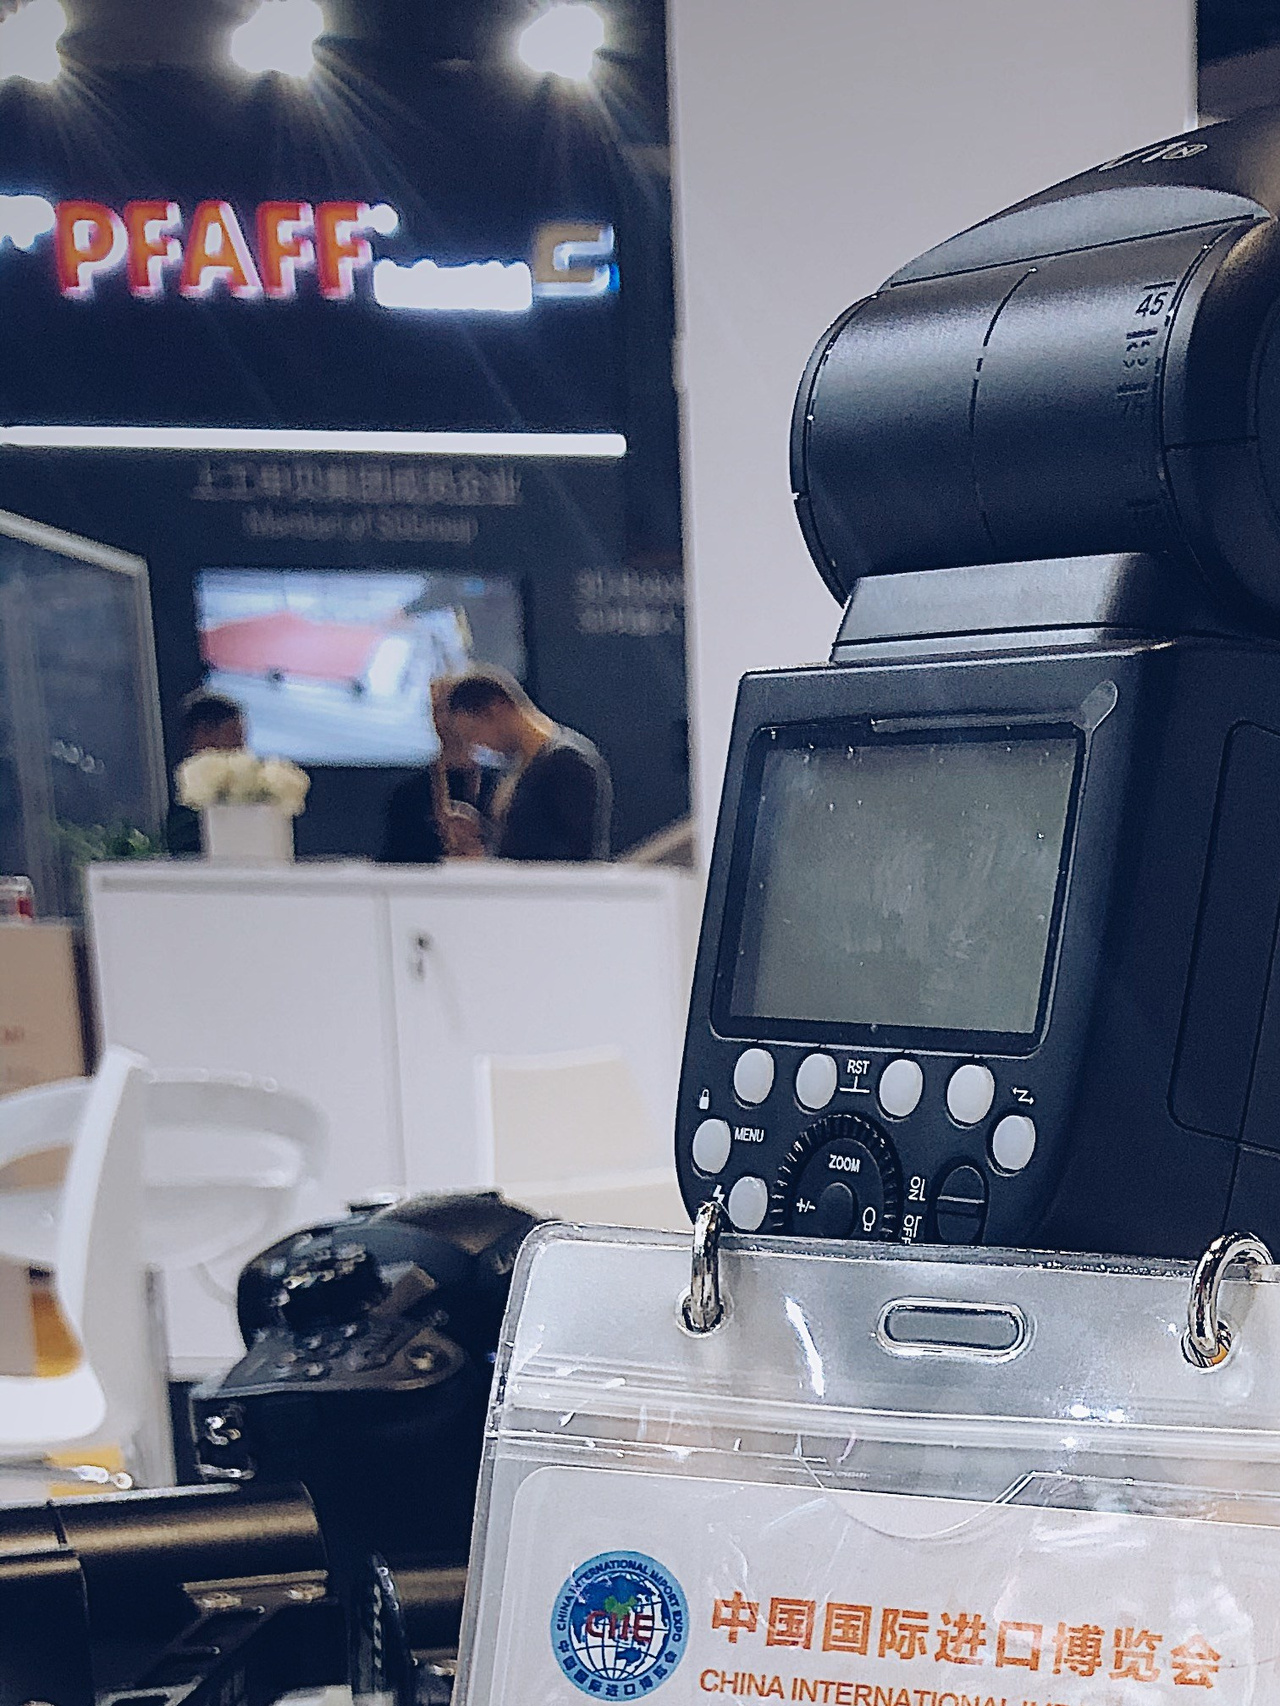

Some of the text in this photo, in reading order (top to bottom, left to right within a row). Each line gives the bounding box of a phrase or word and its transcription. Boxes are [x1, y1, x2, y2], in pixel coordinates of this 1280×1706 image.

[55, 200, 374, 298] PFAFF
[1135, 291, 1168, 316] 45
[847, 1059, 870, 1076] RST
[734, 1127, 765, 1143] MENU
[828, 1154, 861, 1173] ZOOM
[908, 1176, 921, 1201] ON
[556, 1595, 576, 1632] CHINA
[568, 1559, 649, 1594] INTERNATIONAL
[711, 1591, 1223, 1689] 中国国际进口博览会
[700, 1669, 785, 1700] CHINA
